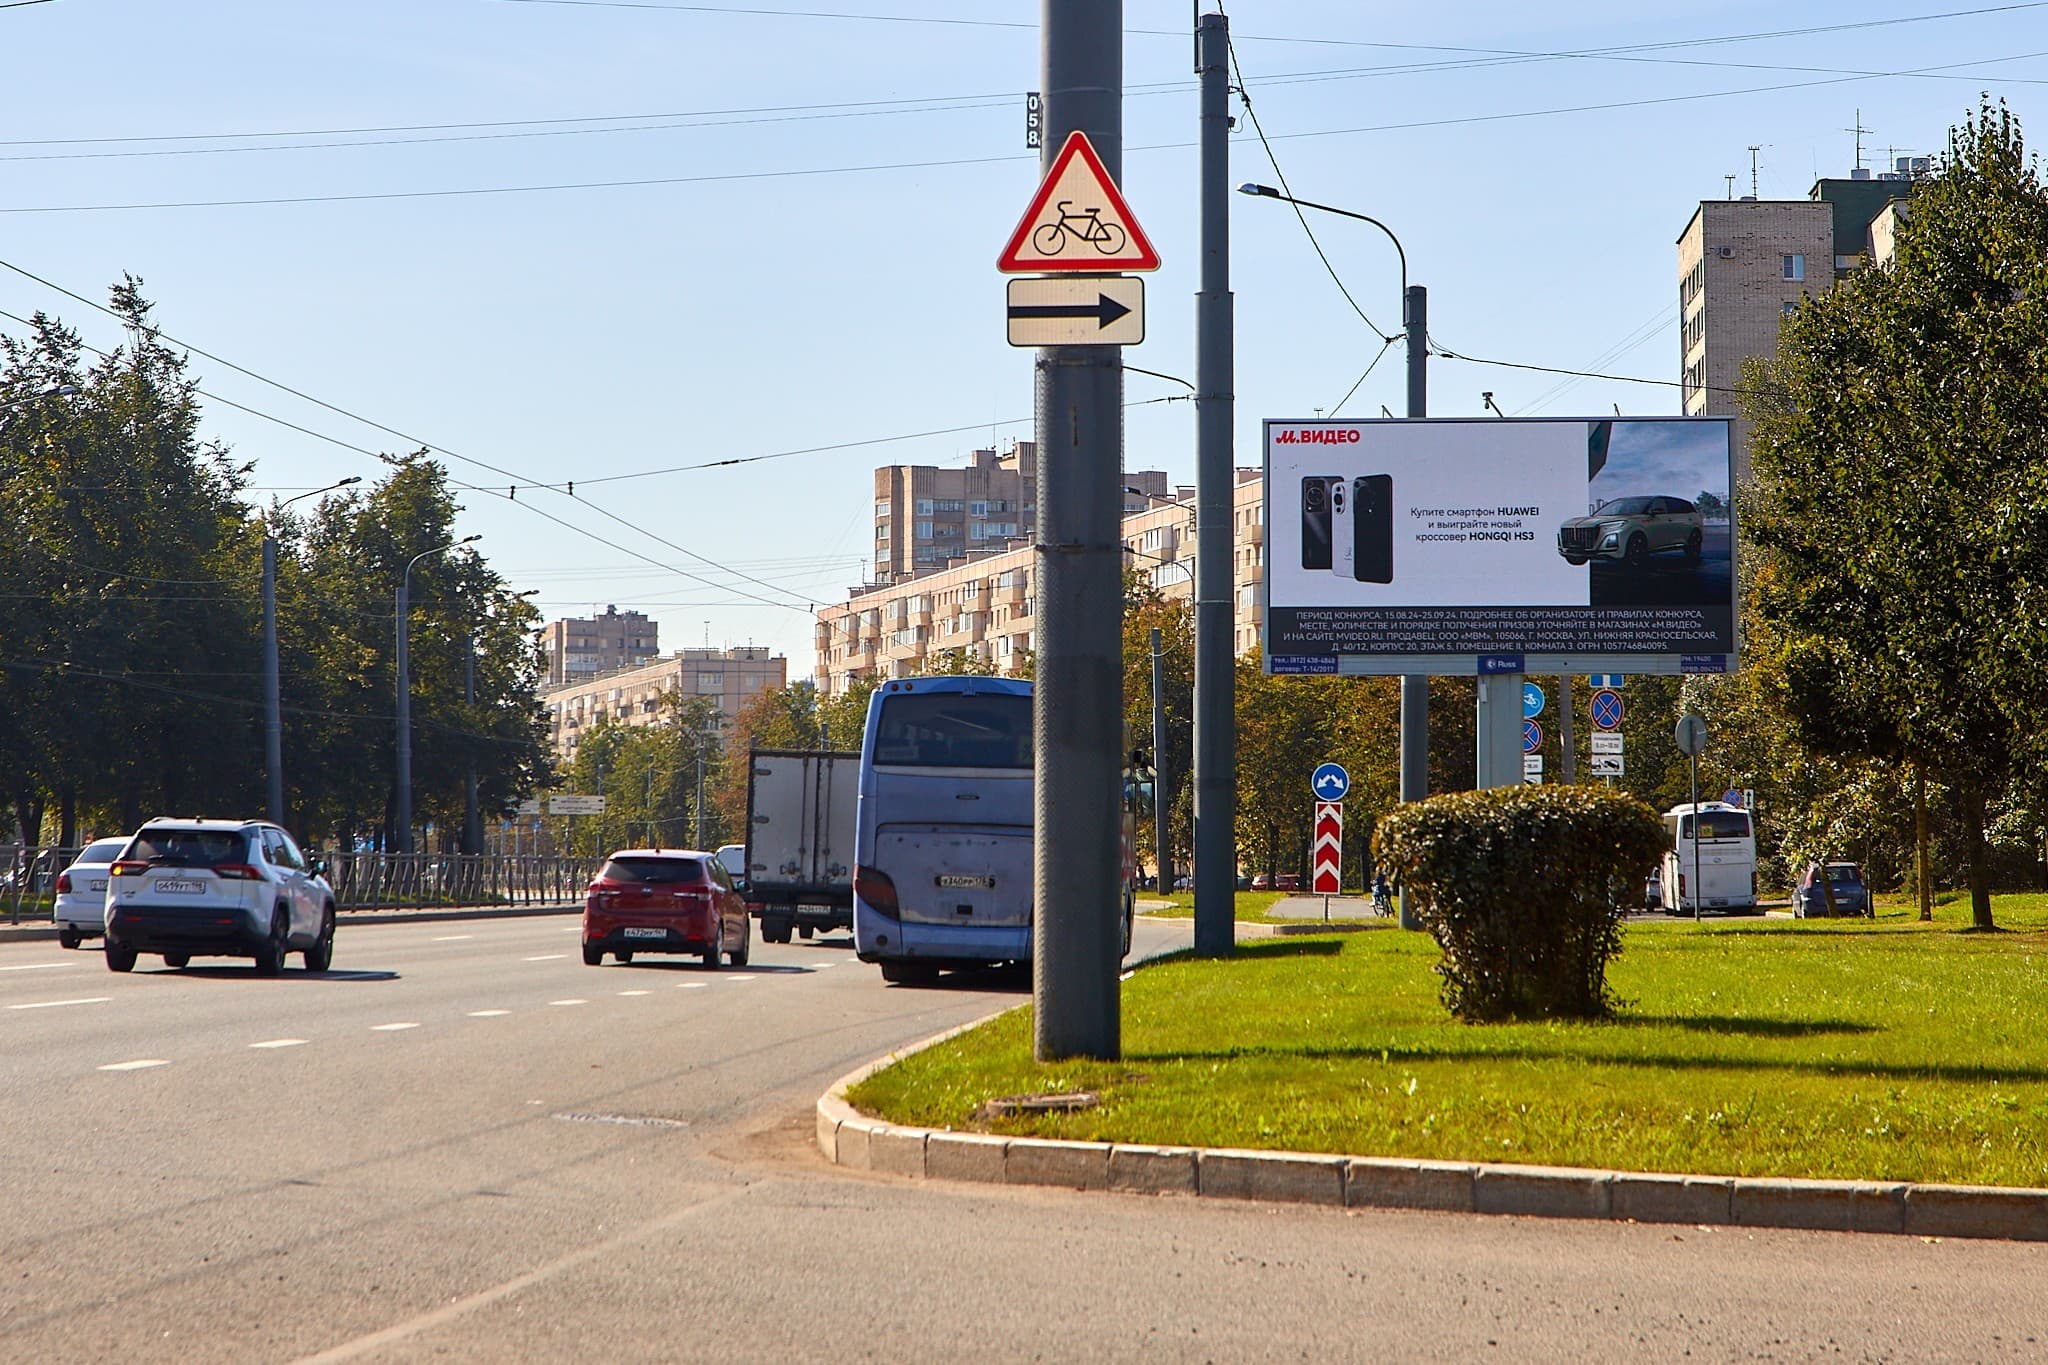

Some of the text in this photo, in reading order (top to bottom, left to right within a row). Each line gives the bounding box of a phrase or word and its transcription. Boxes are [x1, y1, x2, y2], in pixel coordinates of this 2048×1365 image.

[1275, 429, 1360, 445] М.ВИДЕО
[1410, 507, 1539, 519] Купите смартфон HUAWEI
[1437, 520, 1488, 530] выиграйте
[1491, 520, 1522, 529] новый
[1415, 532, 1535, 543] кроссовер HONGQI HS3
[1296, 612, 1333, 620] ПЕРИОД
[1460, 611, 1514, 619] ПОДРОБНЕЕ
[1515, 611, 1529, 619] ОБ
[1530, 611, 1596, 619] ОРГАНИЗАТОРЕ
[1598, 611, 1605, 619] И
[1606, 611, 1654, 619] ПРАВИЛАХ
[1655, 611, 1704, 619] КОНКУРСА,
[1299, 621, 1702, 630] МЕСТЕ, КОЛИЧЕСТВЕ И ПОРЯДКЕ ПОЛУЧЕНИЯ ПРИЗОВ УТОЧНЯЙТЕ В МАГАЗИНАХ «М.ВИДЕО»
[1283, 632, 1291, 640] И
[1292, 632, 1304, 640] НА
[1305, 632, 1334, 640] САЙТЕ
[1438, 631, 1459, 640] ООО
[1536, 631, 1577, 640] МОСКВА,
[1578, 631, 1591, 640] УЛ.
[1593, 631, 1634, 640] НИЖНЯЯ
[1635, 631, 1719, 639] КРАСНОСЕЛЬСКАЯ,
[1342, 642, 1369, 651] 40/12,
[1370, 642, 1405, 651] КОРПУС
[1406, 642, 1419, 651] 20,
[1420, 642, 1446, 651] ЭТАЖ
[1456, 642, 1514, 651] ПОМЕЩЕНИЕ
[1524, 641, 1566, 650] КОМНАТА
[1576, 641, 1600, 650] ОГРН
[1498, 660, 1516, 668] Russ
